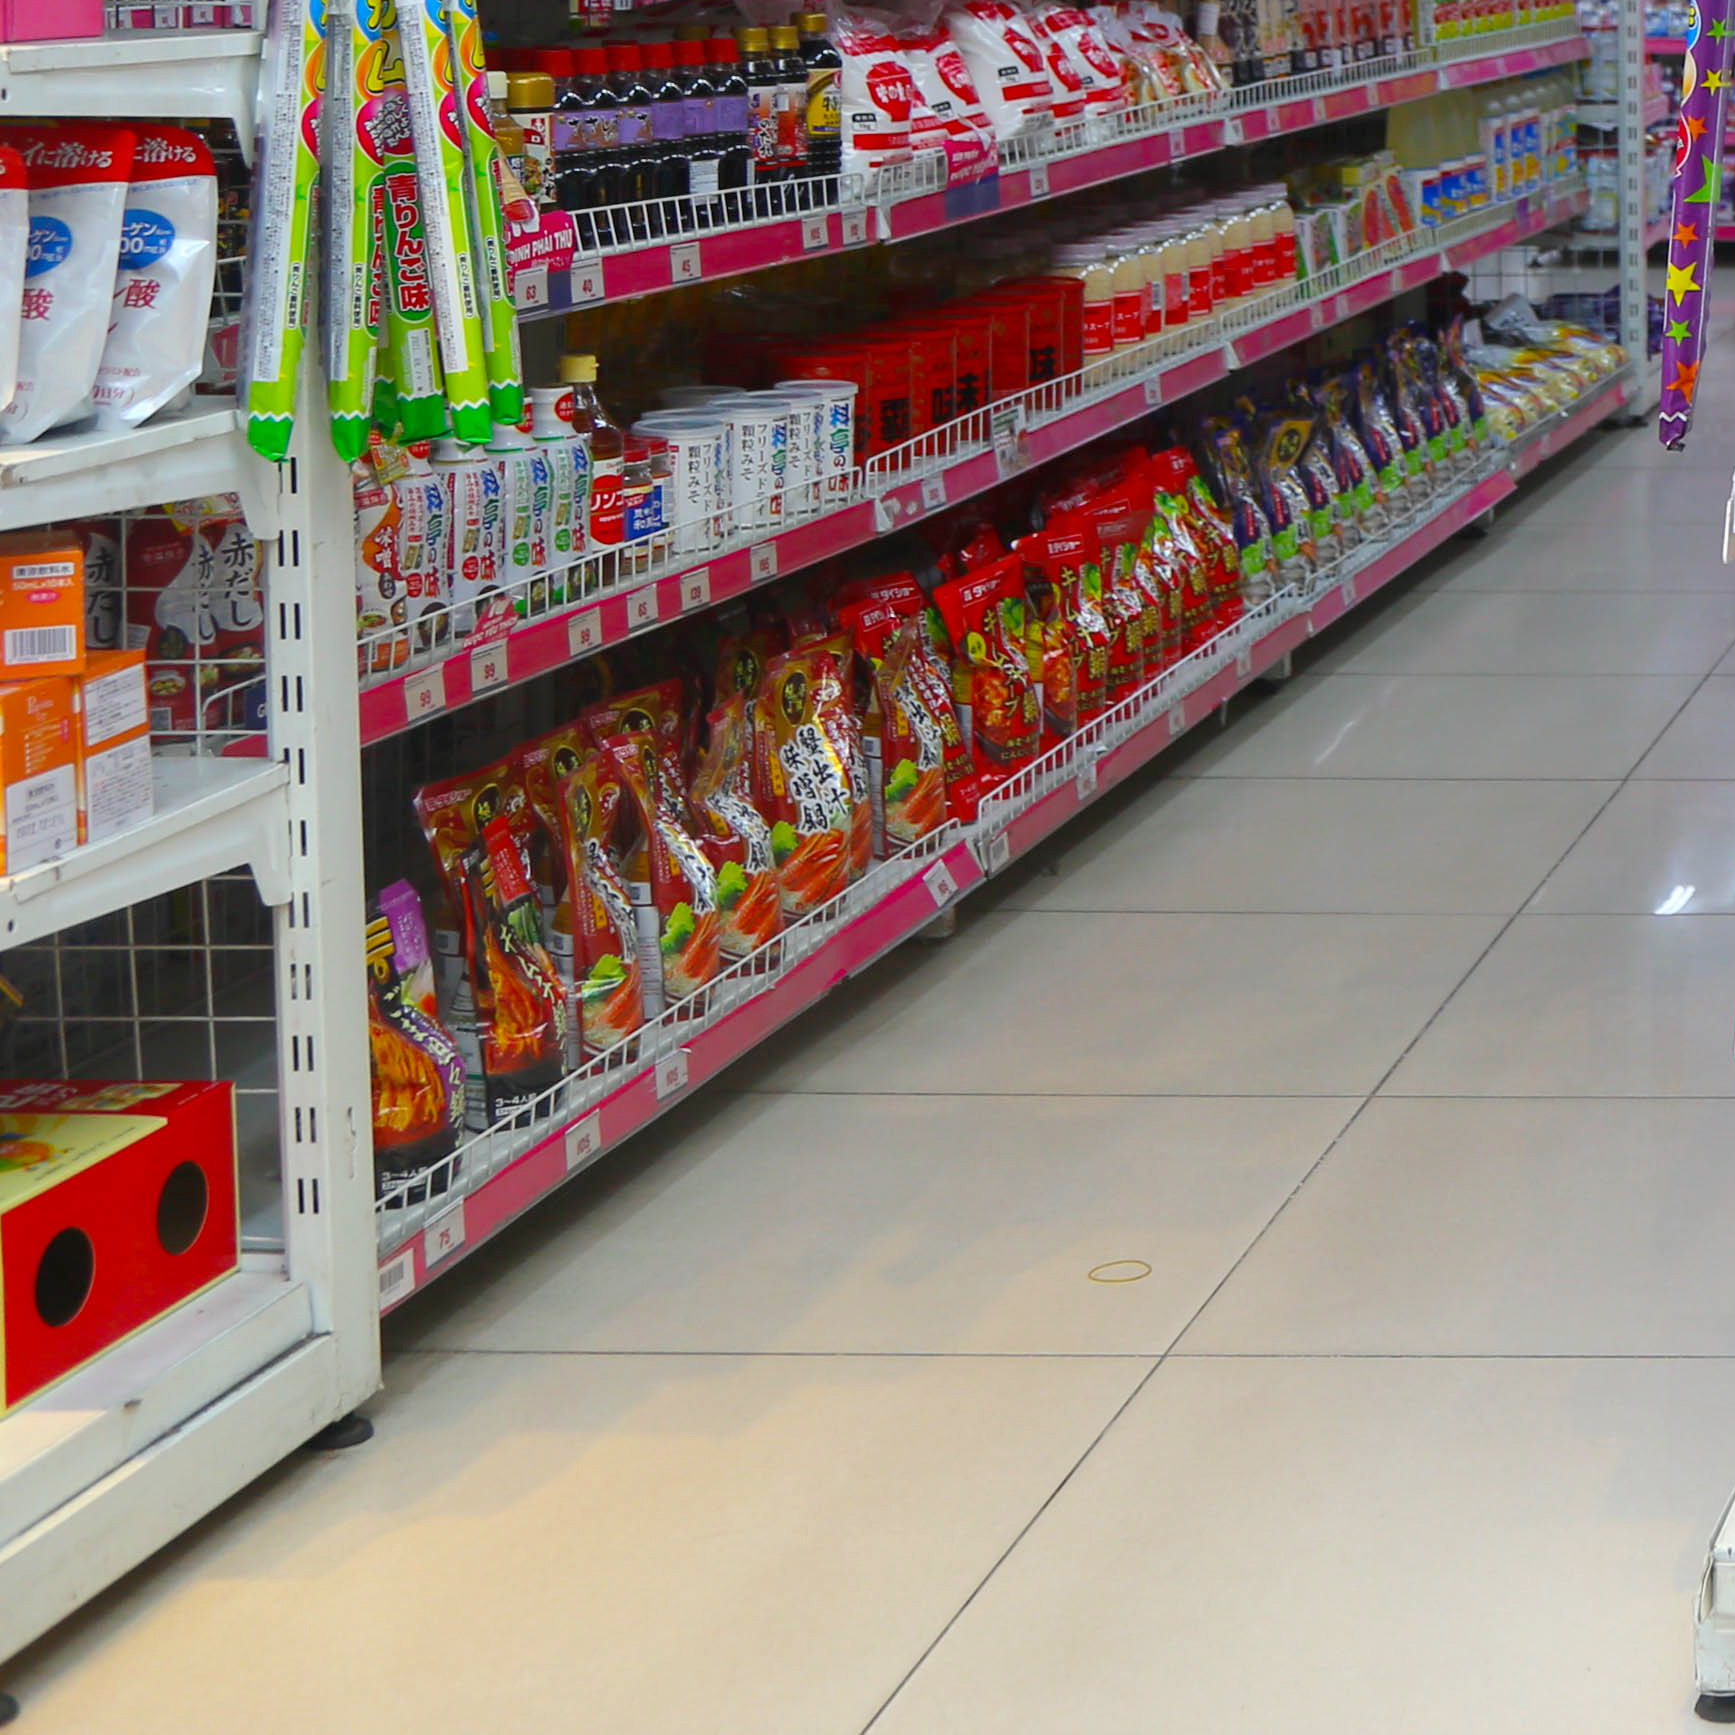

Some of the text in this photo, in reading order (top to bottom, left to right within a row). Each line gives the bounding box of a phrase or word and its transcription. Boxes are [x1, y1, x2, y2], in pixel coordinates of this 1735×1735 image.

[386, 174, 431, 310] 青りんご味
[222, 532, 255, 628] 赤だし
